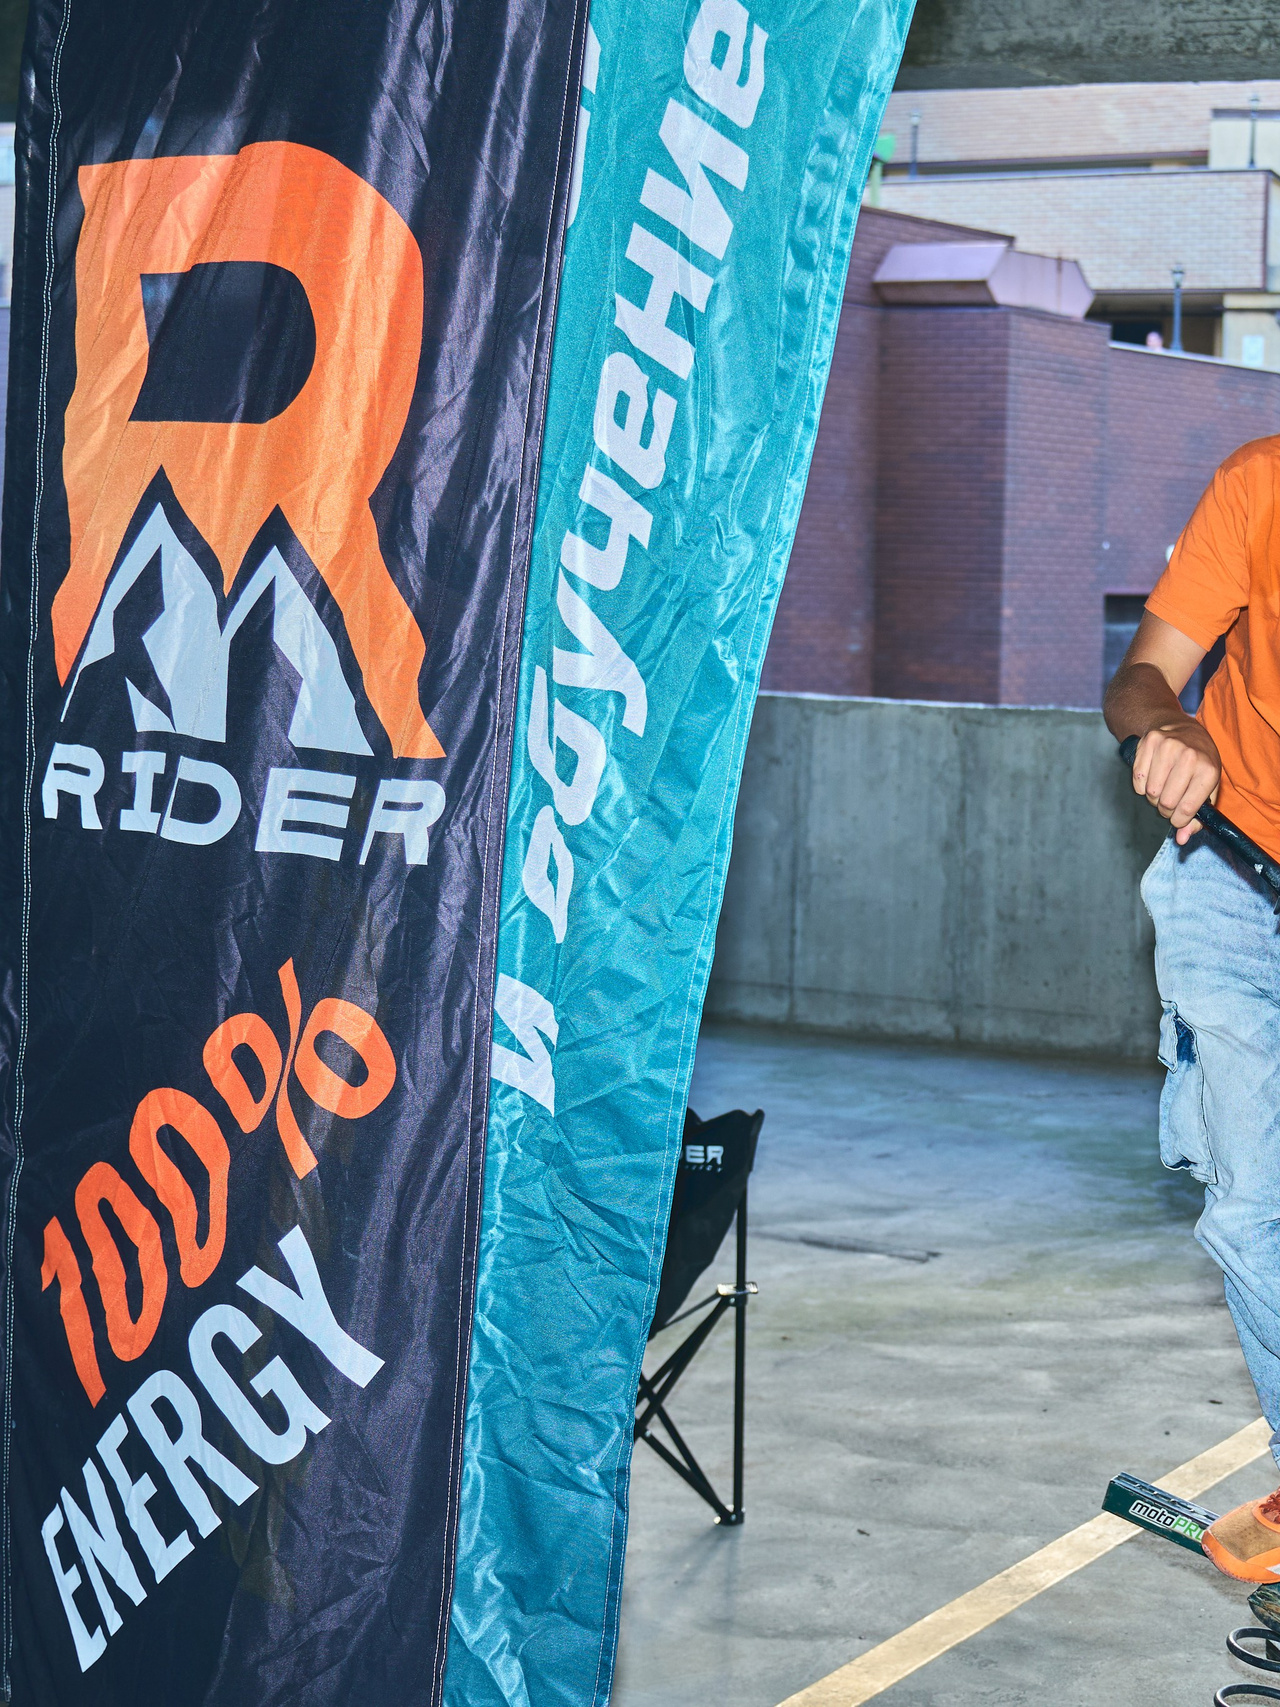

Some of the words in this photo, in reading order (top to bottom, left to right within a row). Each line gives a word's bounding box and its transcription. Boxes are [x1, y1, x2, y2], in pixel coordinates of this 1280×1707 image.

[522, 0, 769, 944] обучение
[42, 742, 447, 865] RIDER
[41, 957, 397, 1409] 100%
[41, 1225, 385, 1673] ENERGY
